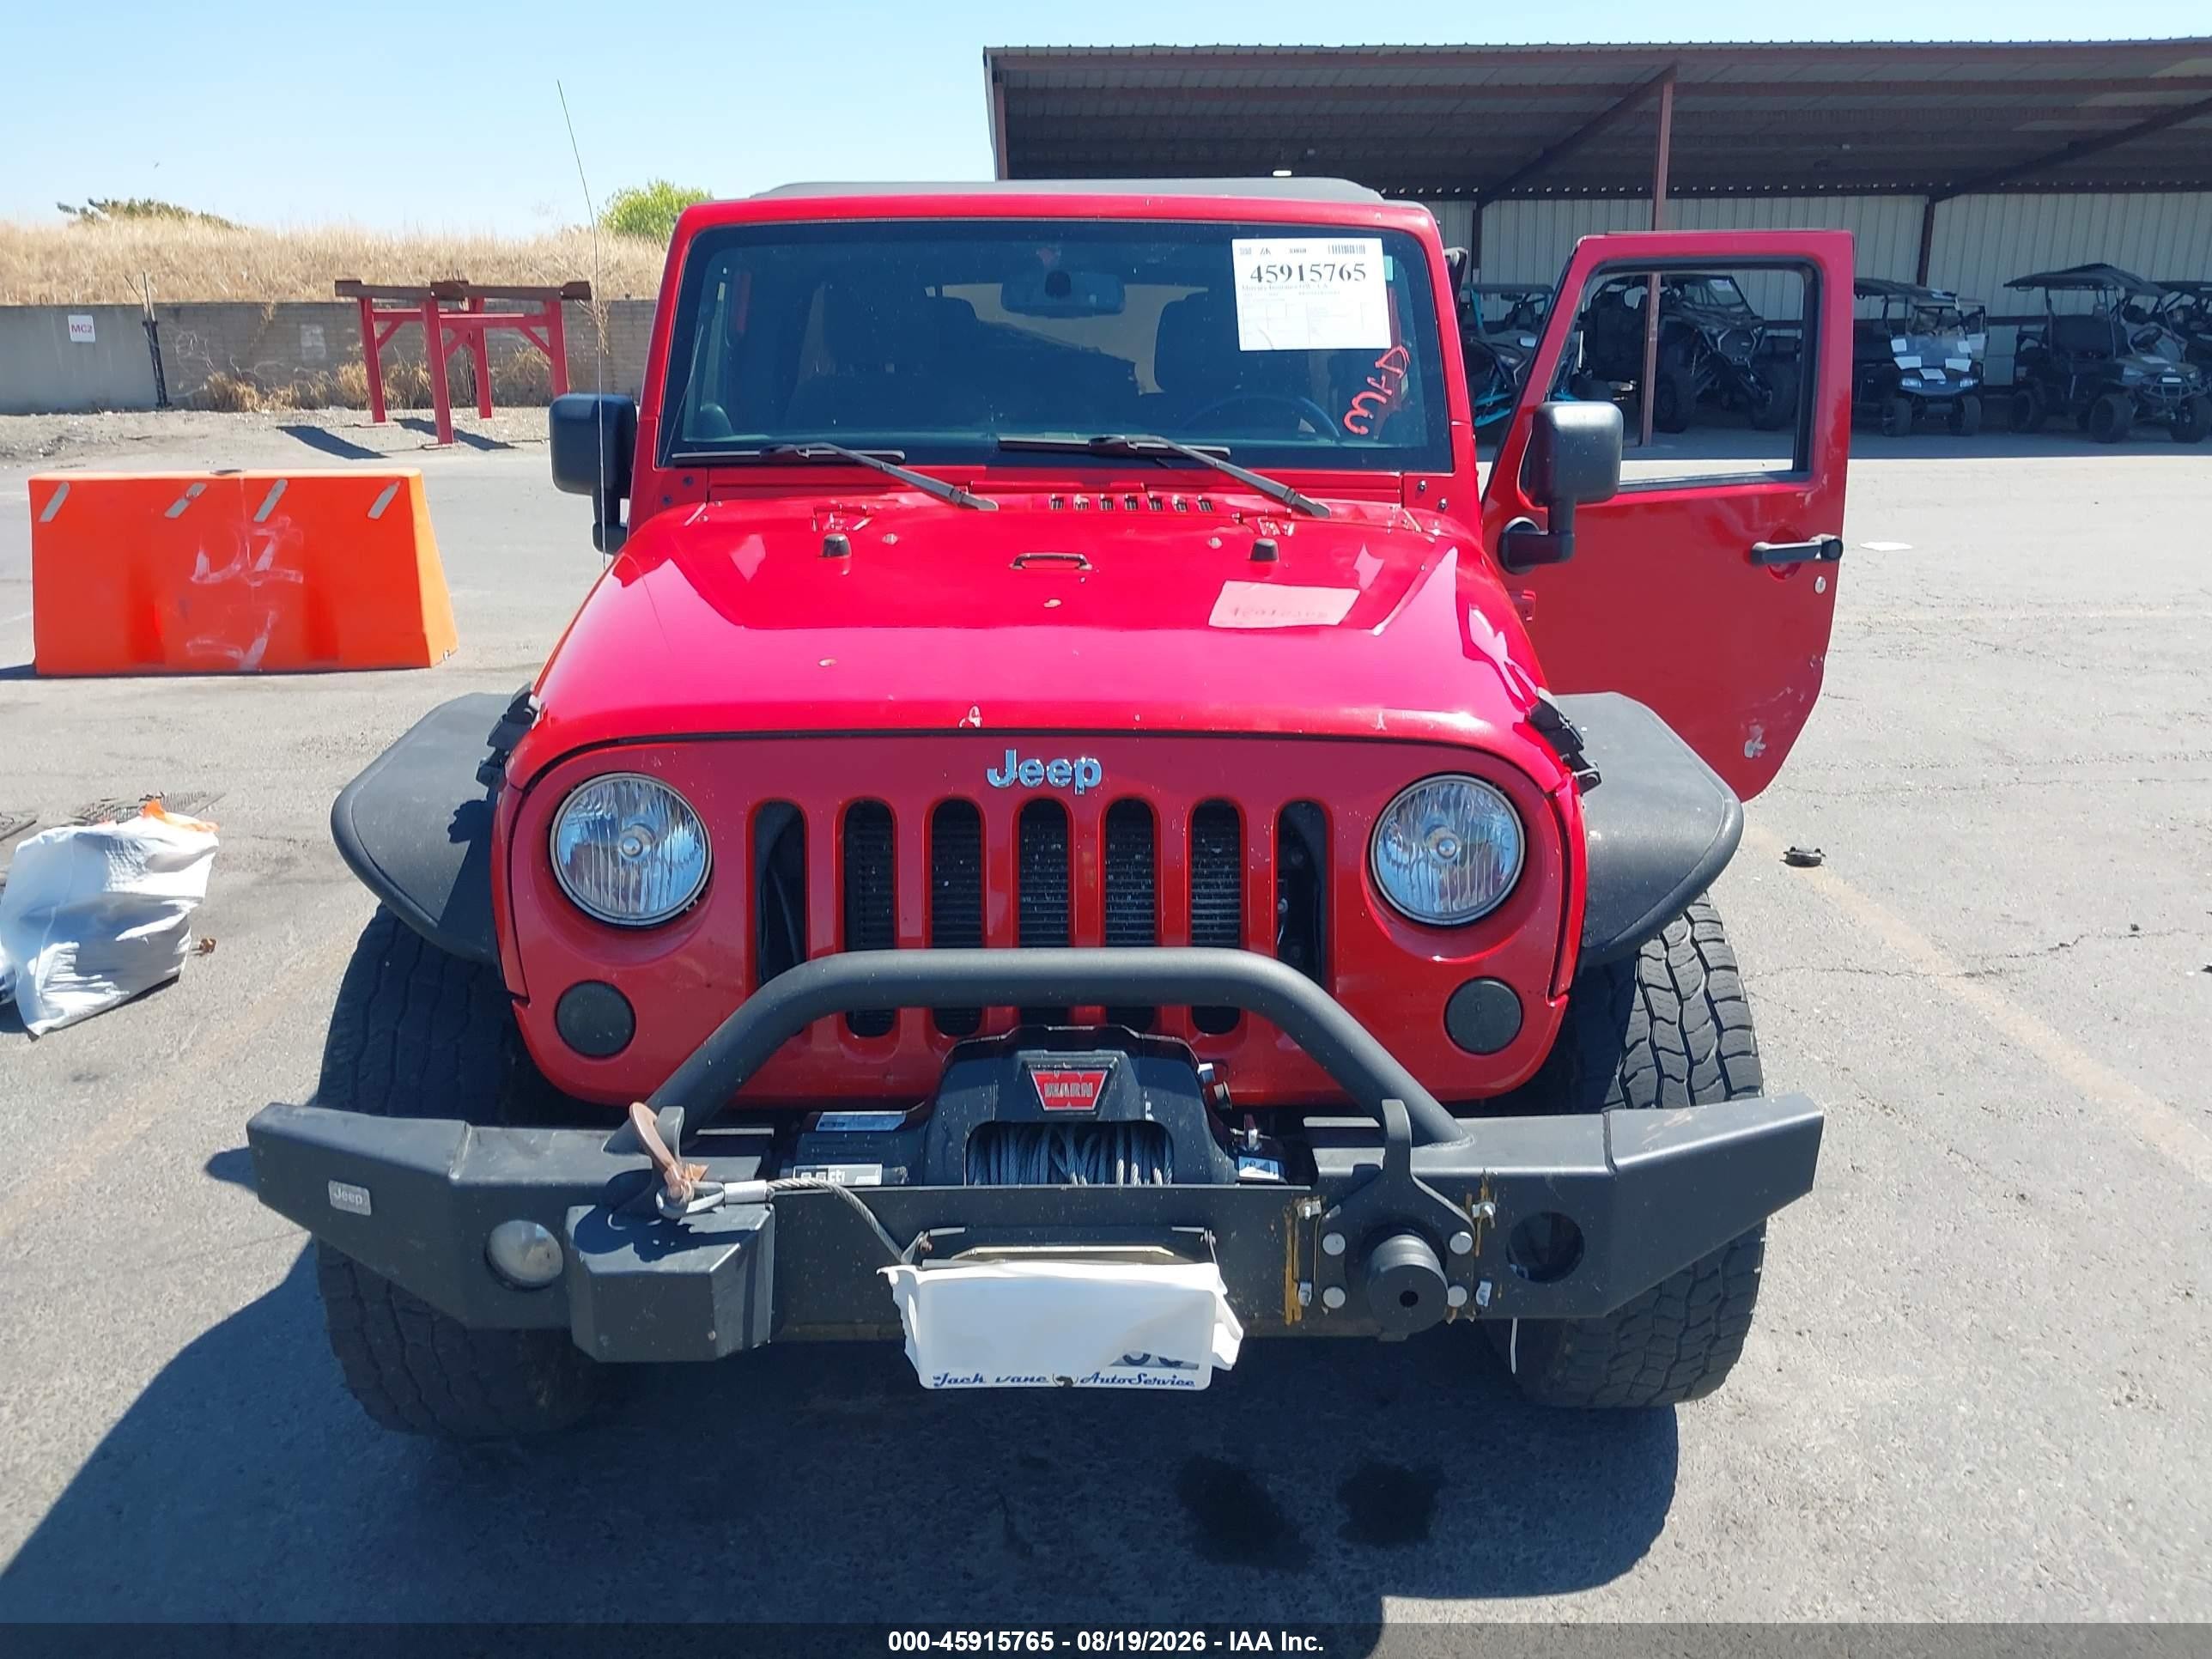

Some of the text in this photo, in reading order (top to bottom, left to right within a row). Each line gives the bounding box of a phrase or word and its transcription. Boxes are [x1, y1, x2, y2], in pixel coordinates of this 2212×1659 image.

[1249, 262, 1367, 284] 45915765
[70, 324, 93, 334] MC2
[987, 749, 1103, 796] Jeep
[1043, 1082, 1093, 1097] WARN
[333, 1187, 363, 1206] Jeep
[933, 1371, 985, 1387] Jack
